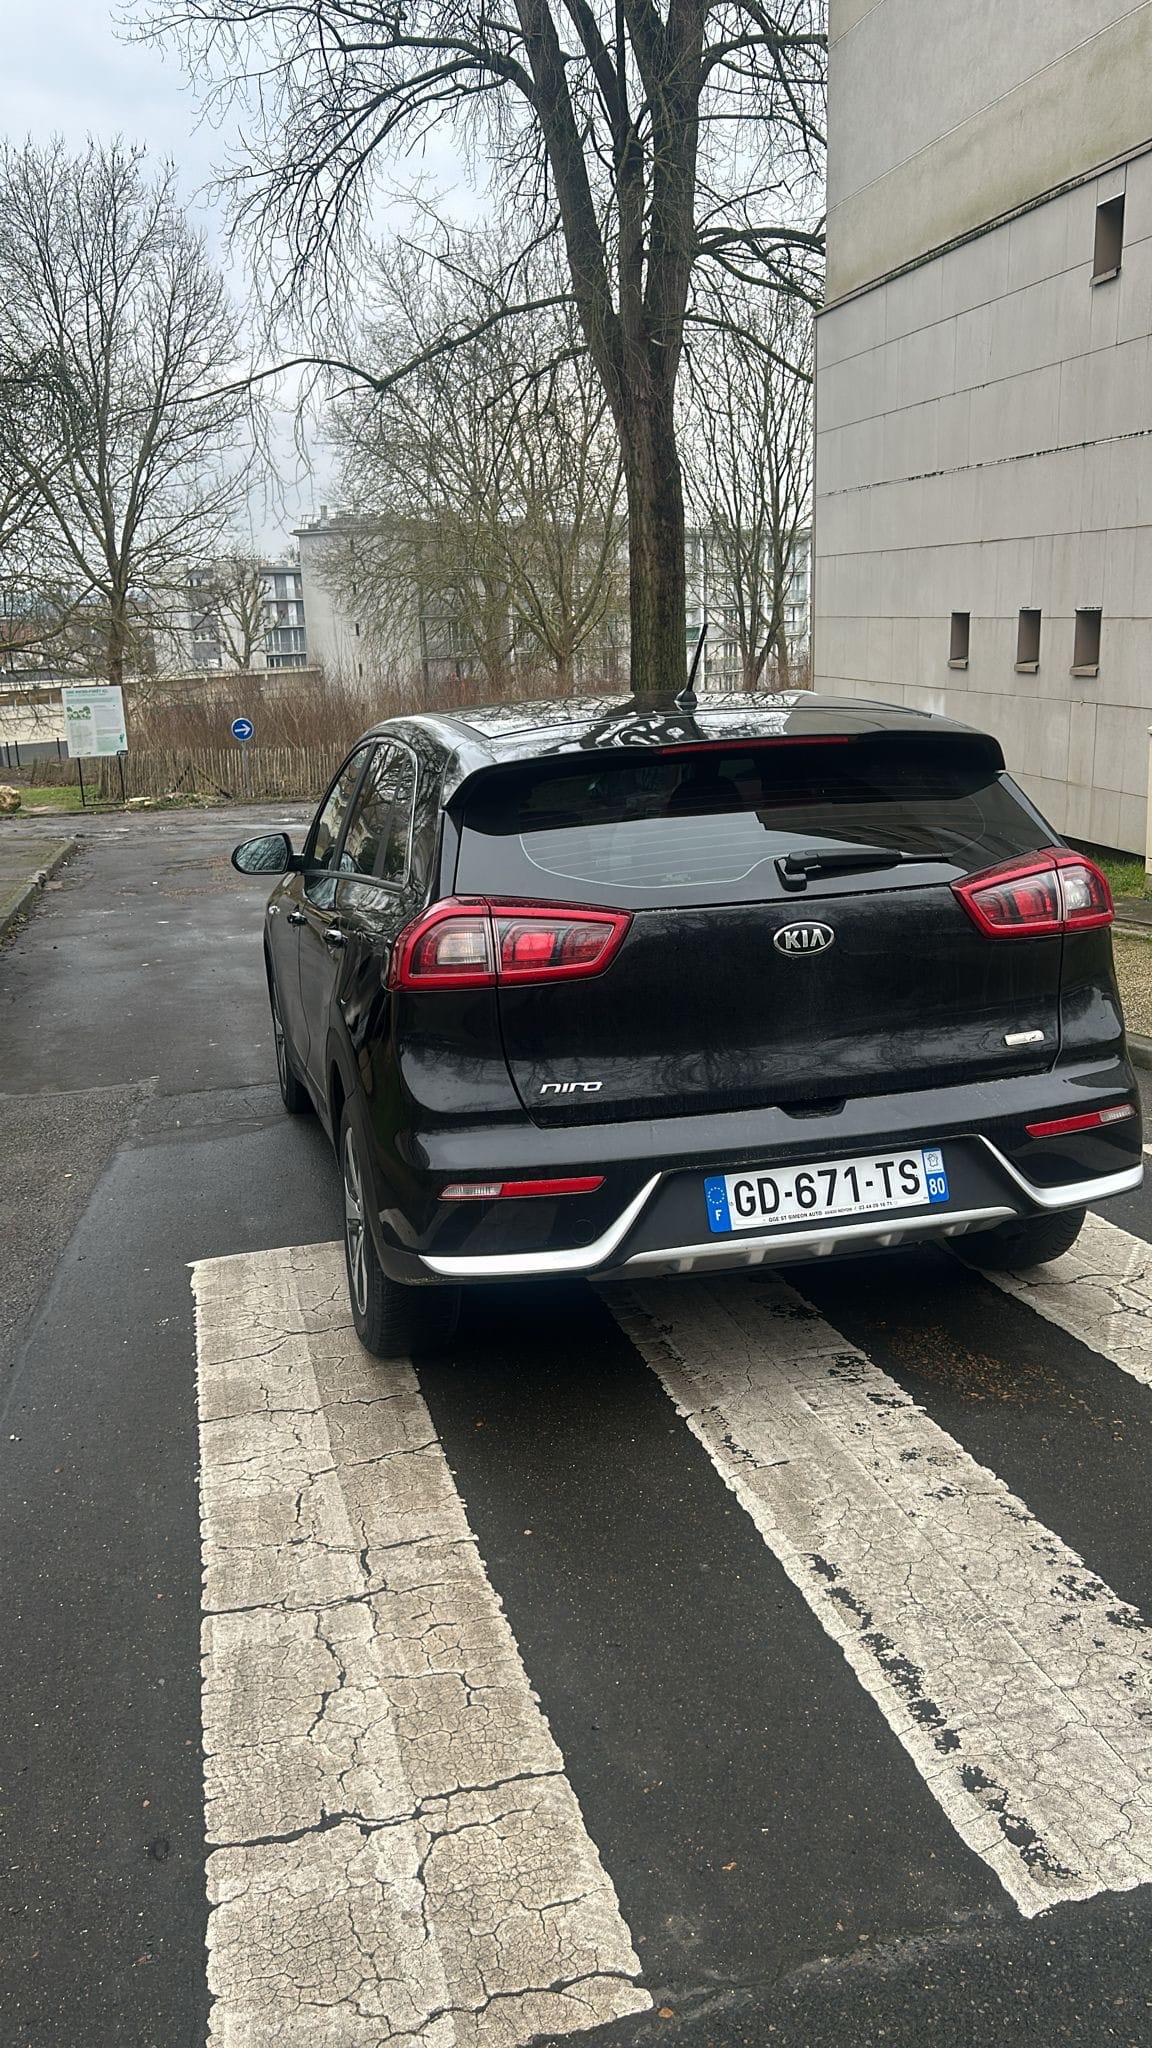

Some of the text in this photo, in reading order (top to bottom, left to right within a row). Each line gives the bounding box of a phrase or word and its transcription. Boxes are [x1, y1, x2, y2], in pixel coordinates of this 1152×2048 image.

[784, 928, 825, 949] KIA
[733, 1159, 921, 1217] GD-671-TS
[929, 1177, 945, 1195] 80
[715, 1209, 722, 1221] F
